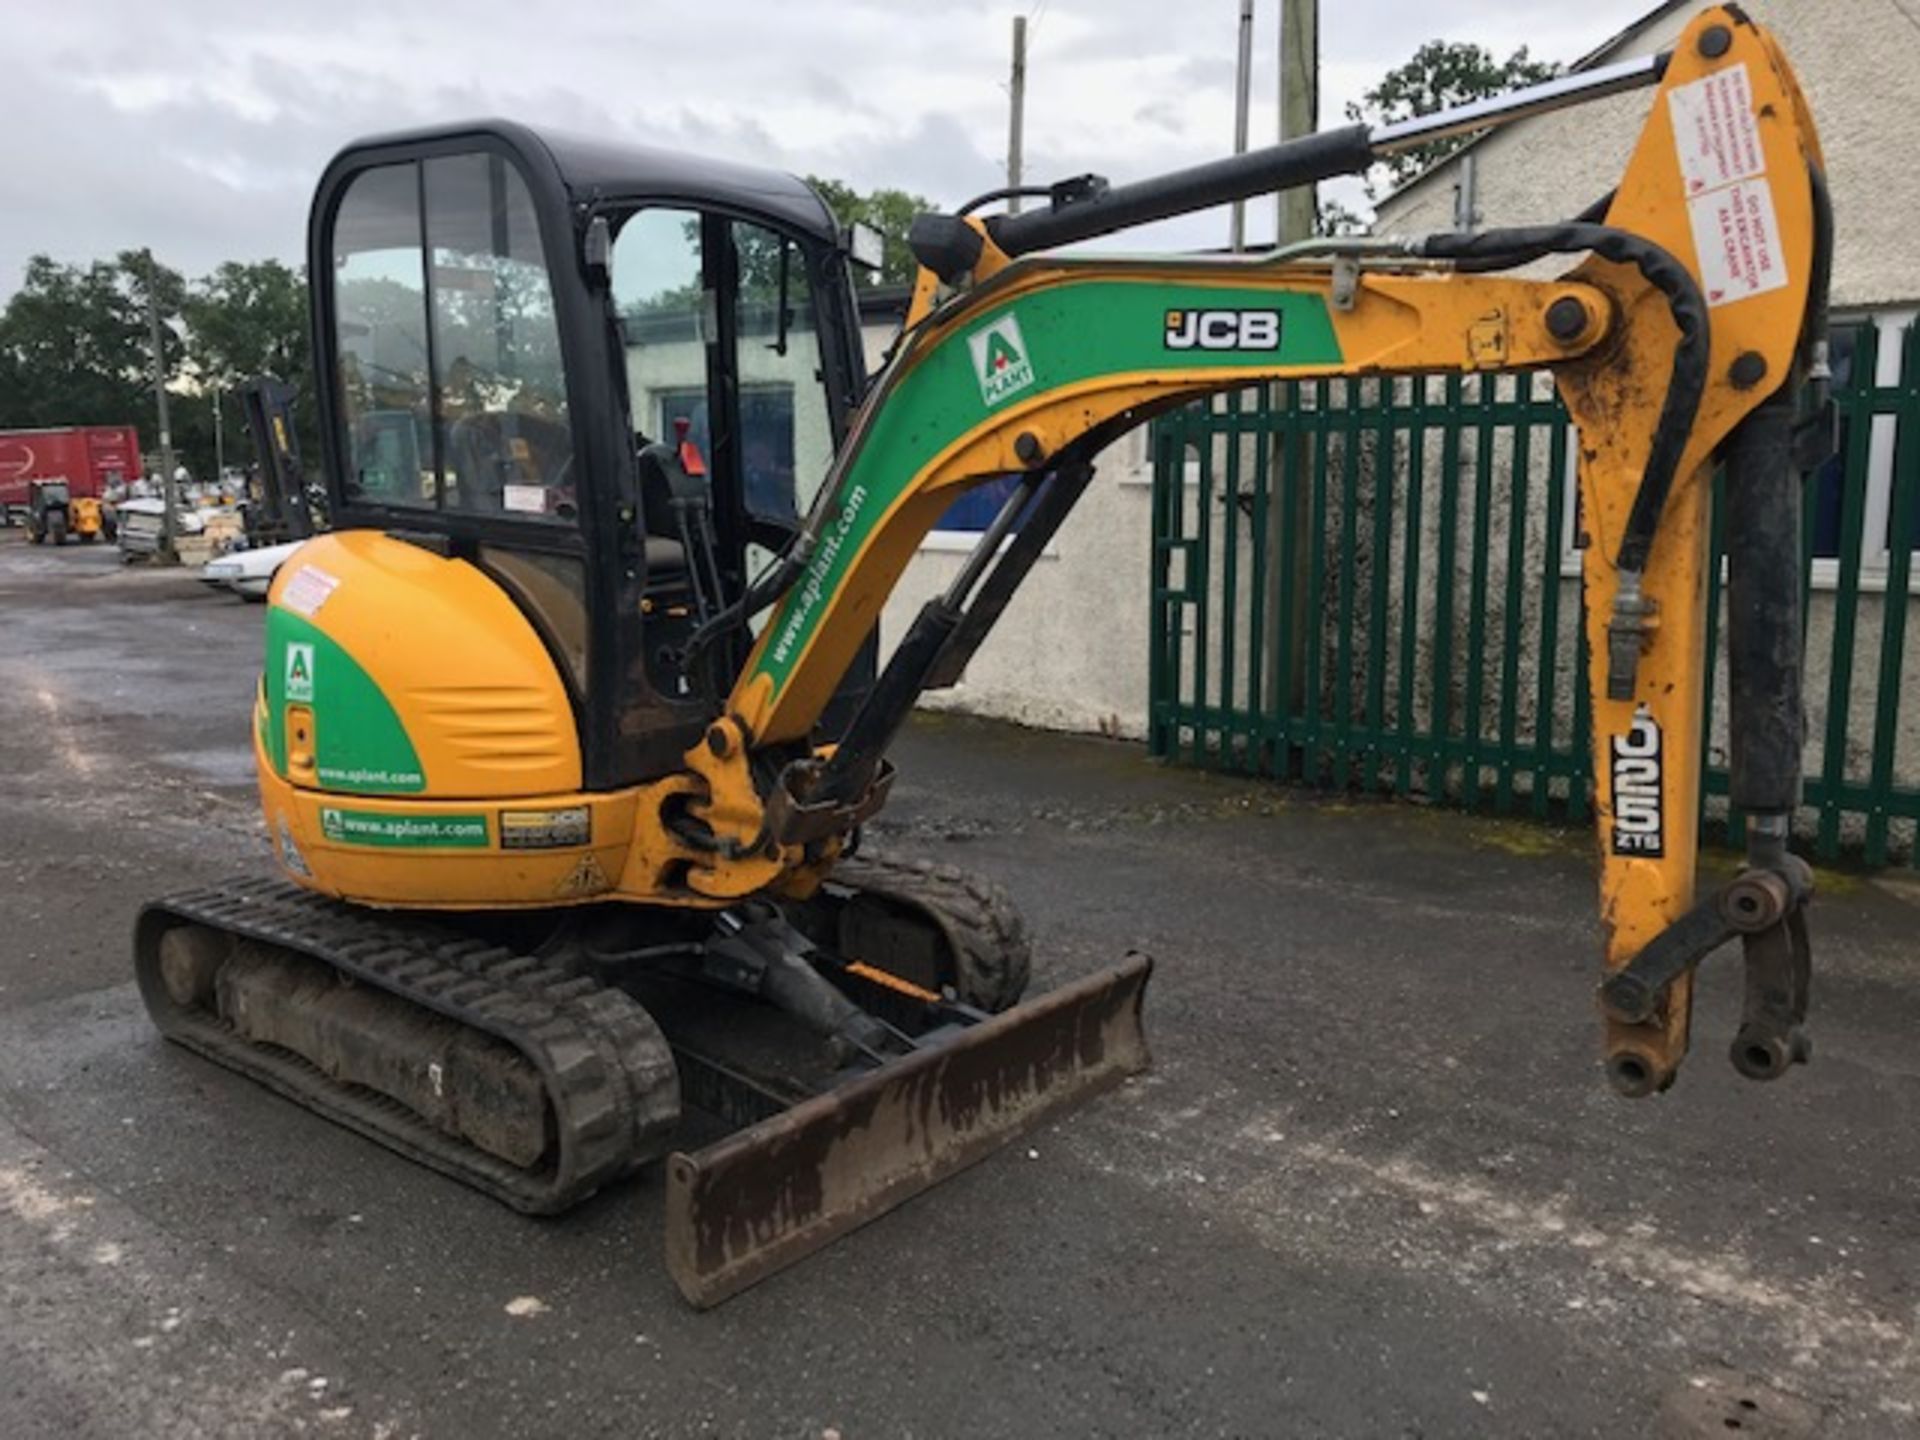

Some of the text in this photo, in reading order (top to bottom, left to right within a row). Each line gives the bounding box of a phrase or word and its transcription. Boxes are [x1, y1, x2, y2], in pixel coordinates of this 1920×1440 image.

[1717, 207, 1730, 223] AS
[1730, 186, 1744, 214] THIS
[1746, 194, 1771, 272] DO NOT USE
[1723, 237, 1741, 278] CRANE
[1734, 216, 1759, 290] EXCAVATOR
[1166, 311, 1279, 349] JCB
[985, 364, 1031, 400] PLANT
[773, 485, 868, 664] www.aplant.com
[318, 767, 422, 784] www.aplant.com
[343, 819, 484, 839] www.aplant.com
